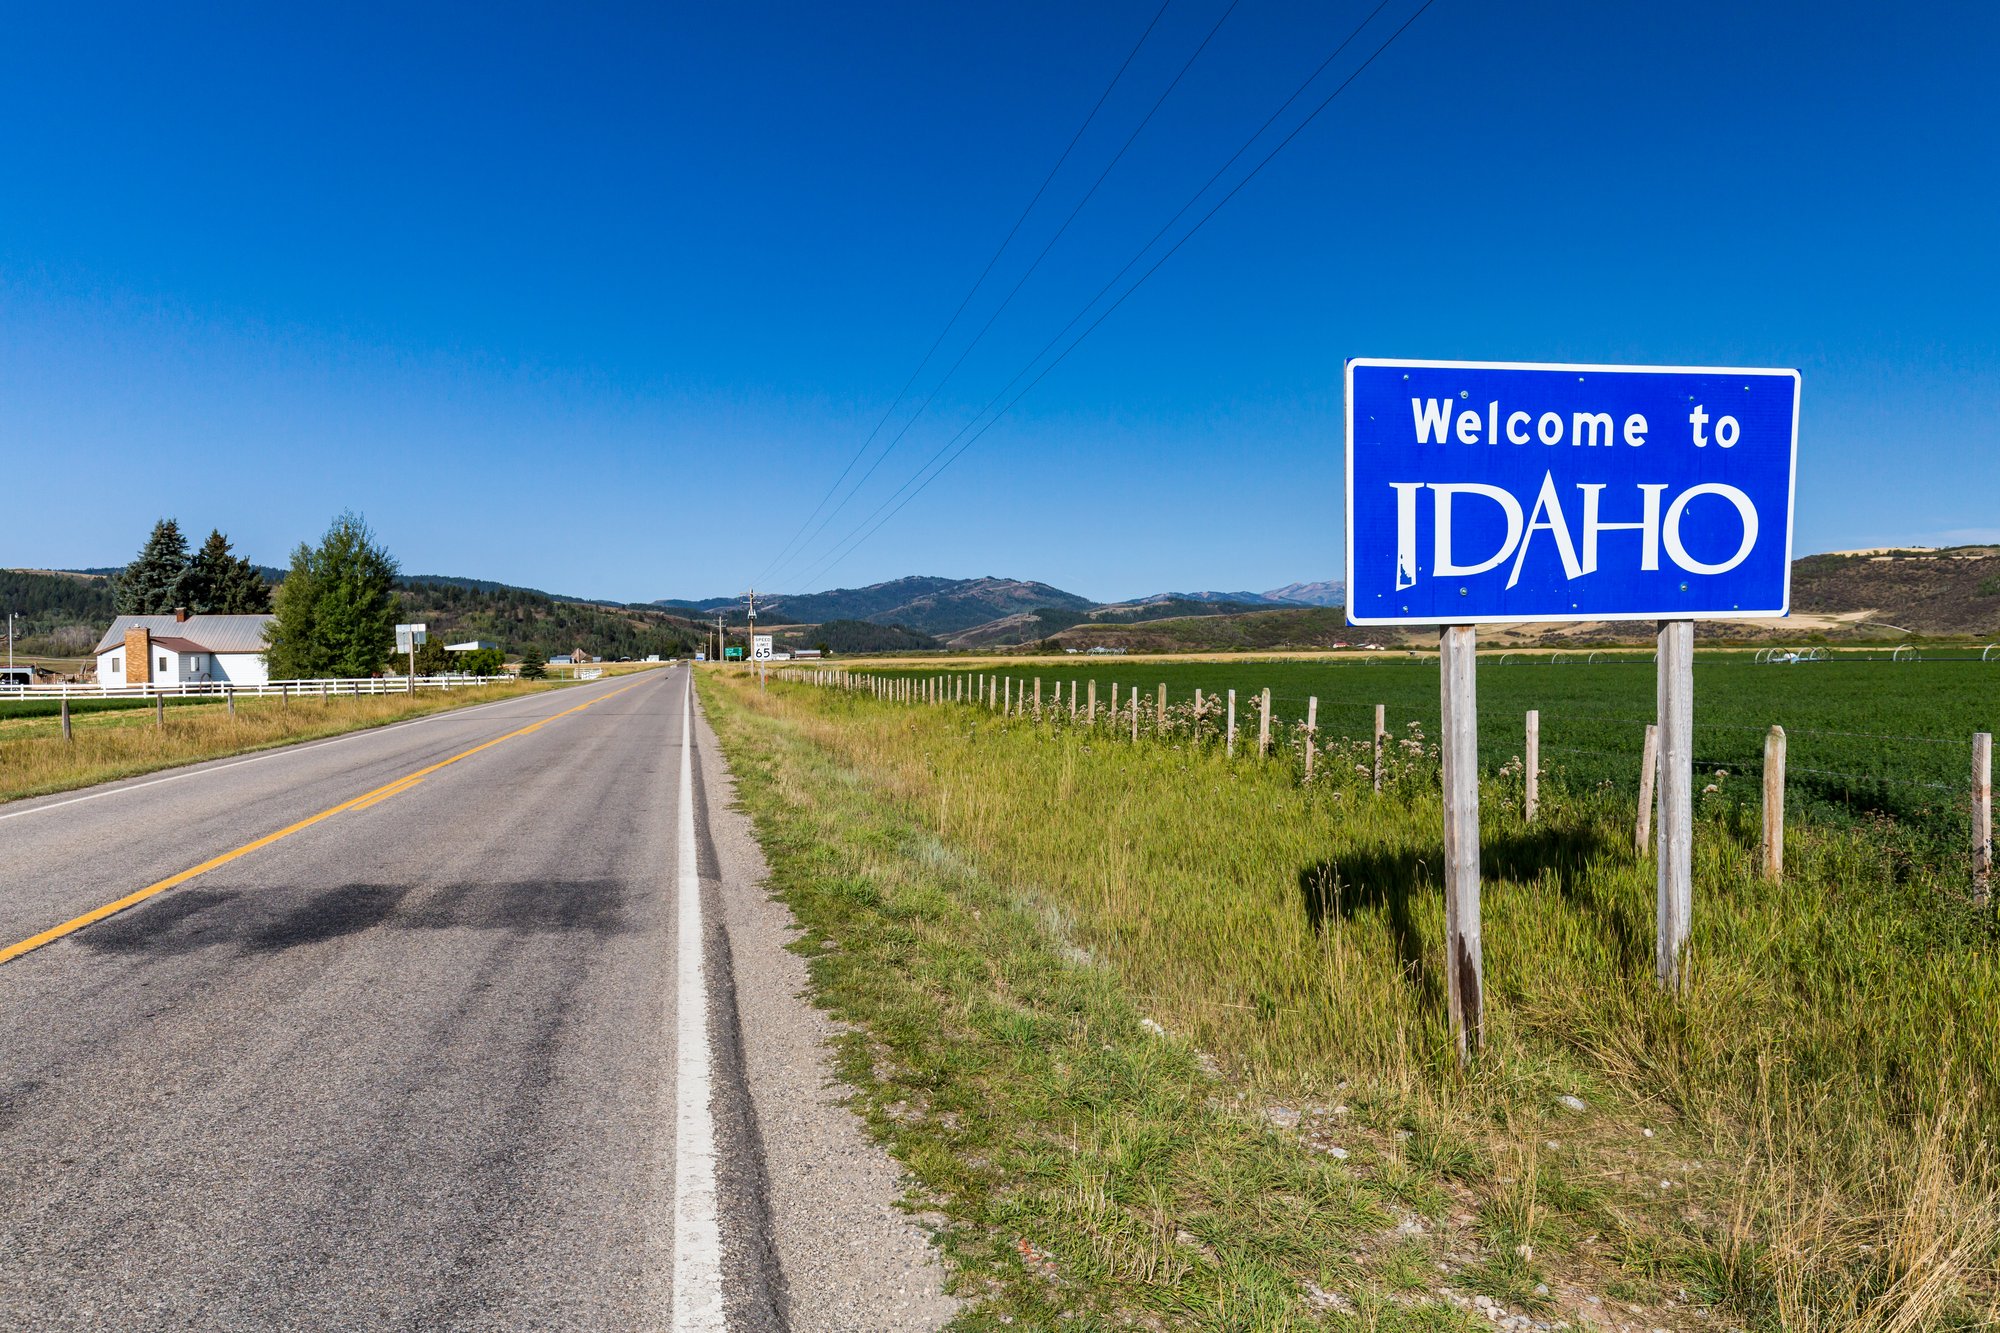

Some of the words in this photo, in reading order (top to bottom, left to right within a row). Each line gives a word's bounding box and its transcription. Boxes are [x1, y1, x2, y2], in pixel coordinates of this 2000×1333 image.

[1411, 398, 1648, 447] Welcome
[1689, 405, 1740, 449] to
[1388, 470, 1759, 592] IDAHO
[755, 648, 771, 658] 65
